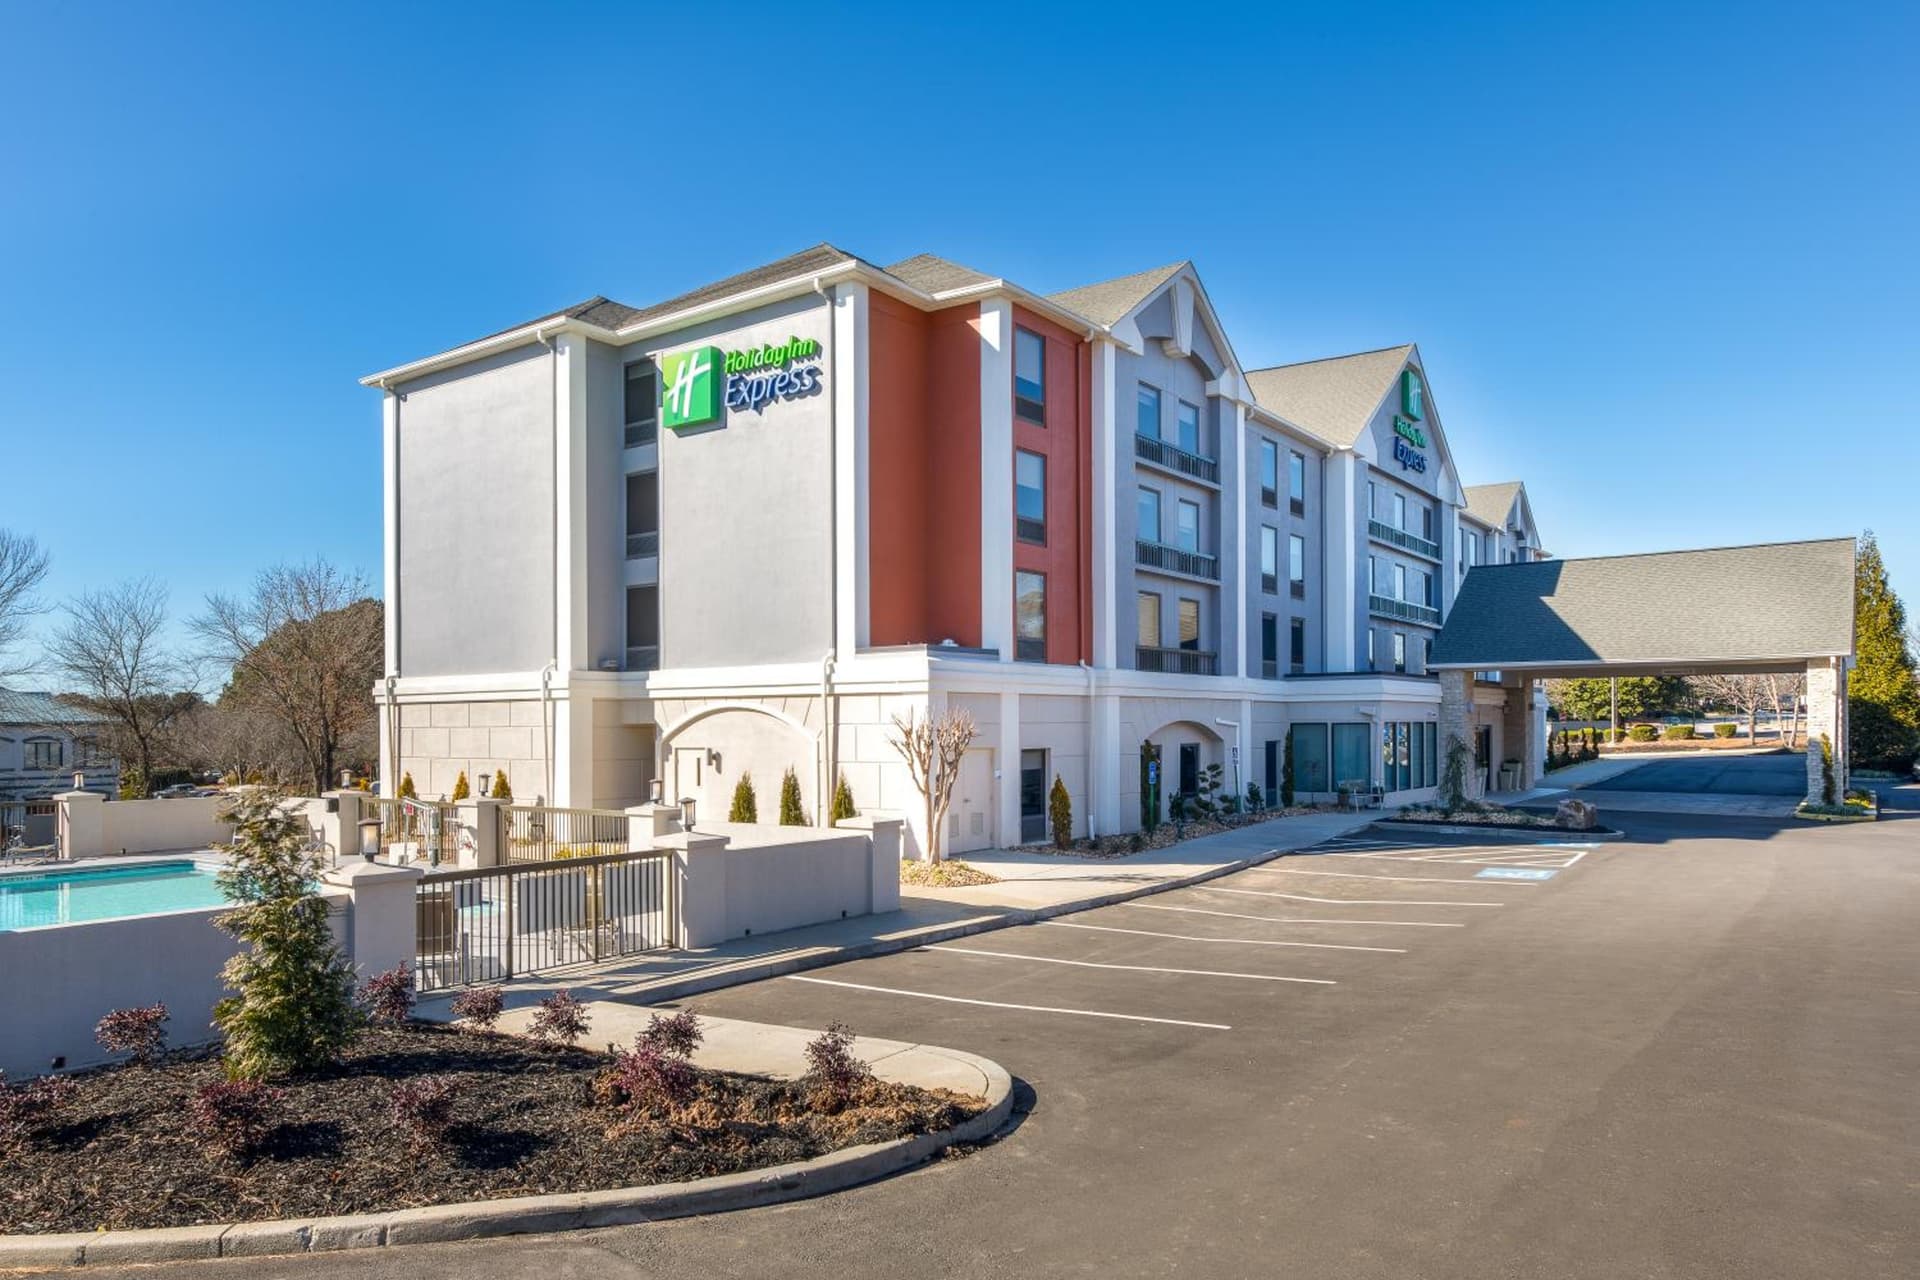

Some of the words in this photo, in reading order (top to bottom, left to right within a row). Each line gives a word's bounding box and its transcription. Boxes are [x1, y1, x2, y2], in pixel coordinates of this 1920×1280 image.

[725, 346, 786, 374] Holiday
[786, 335, 818, 359] Inn
[724, 365, 817, 409] Express
